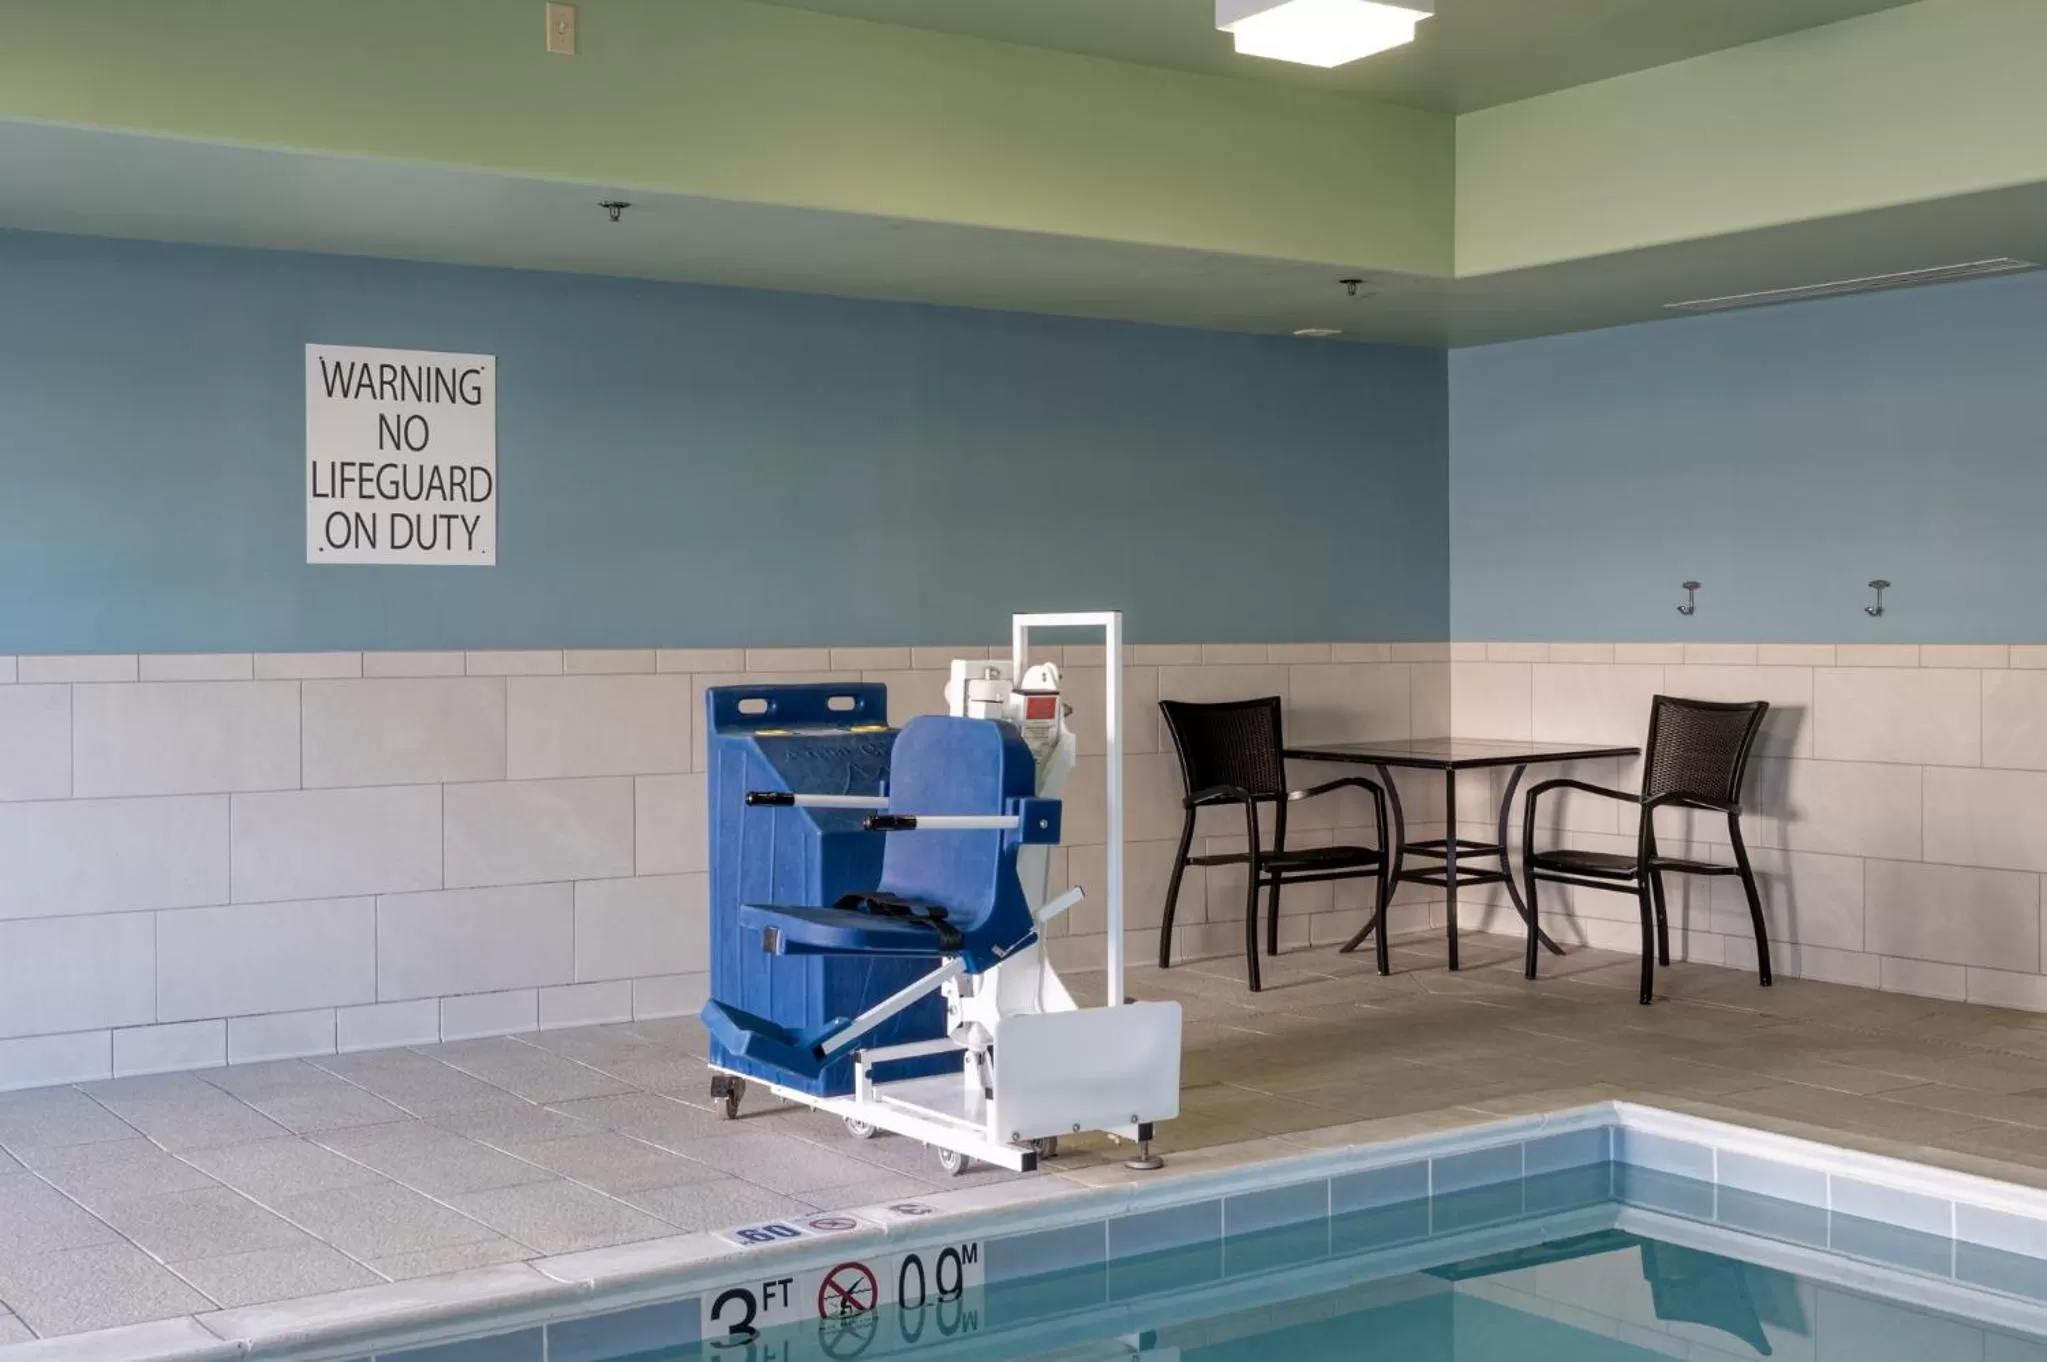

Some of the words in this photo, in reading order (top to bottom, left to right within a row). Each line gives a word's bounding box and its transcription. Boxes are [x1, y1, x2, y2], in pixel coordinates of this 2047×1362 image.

[321, 360, 482, 405] WARNING
[379, 413, 429, 452] NO
[312, 461, 493, 502] LIFEGUARD
[325, 511, 377, 549] ON
[390, 513, 480, 551] DUTY
